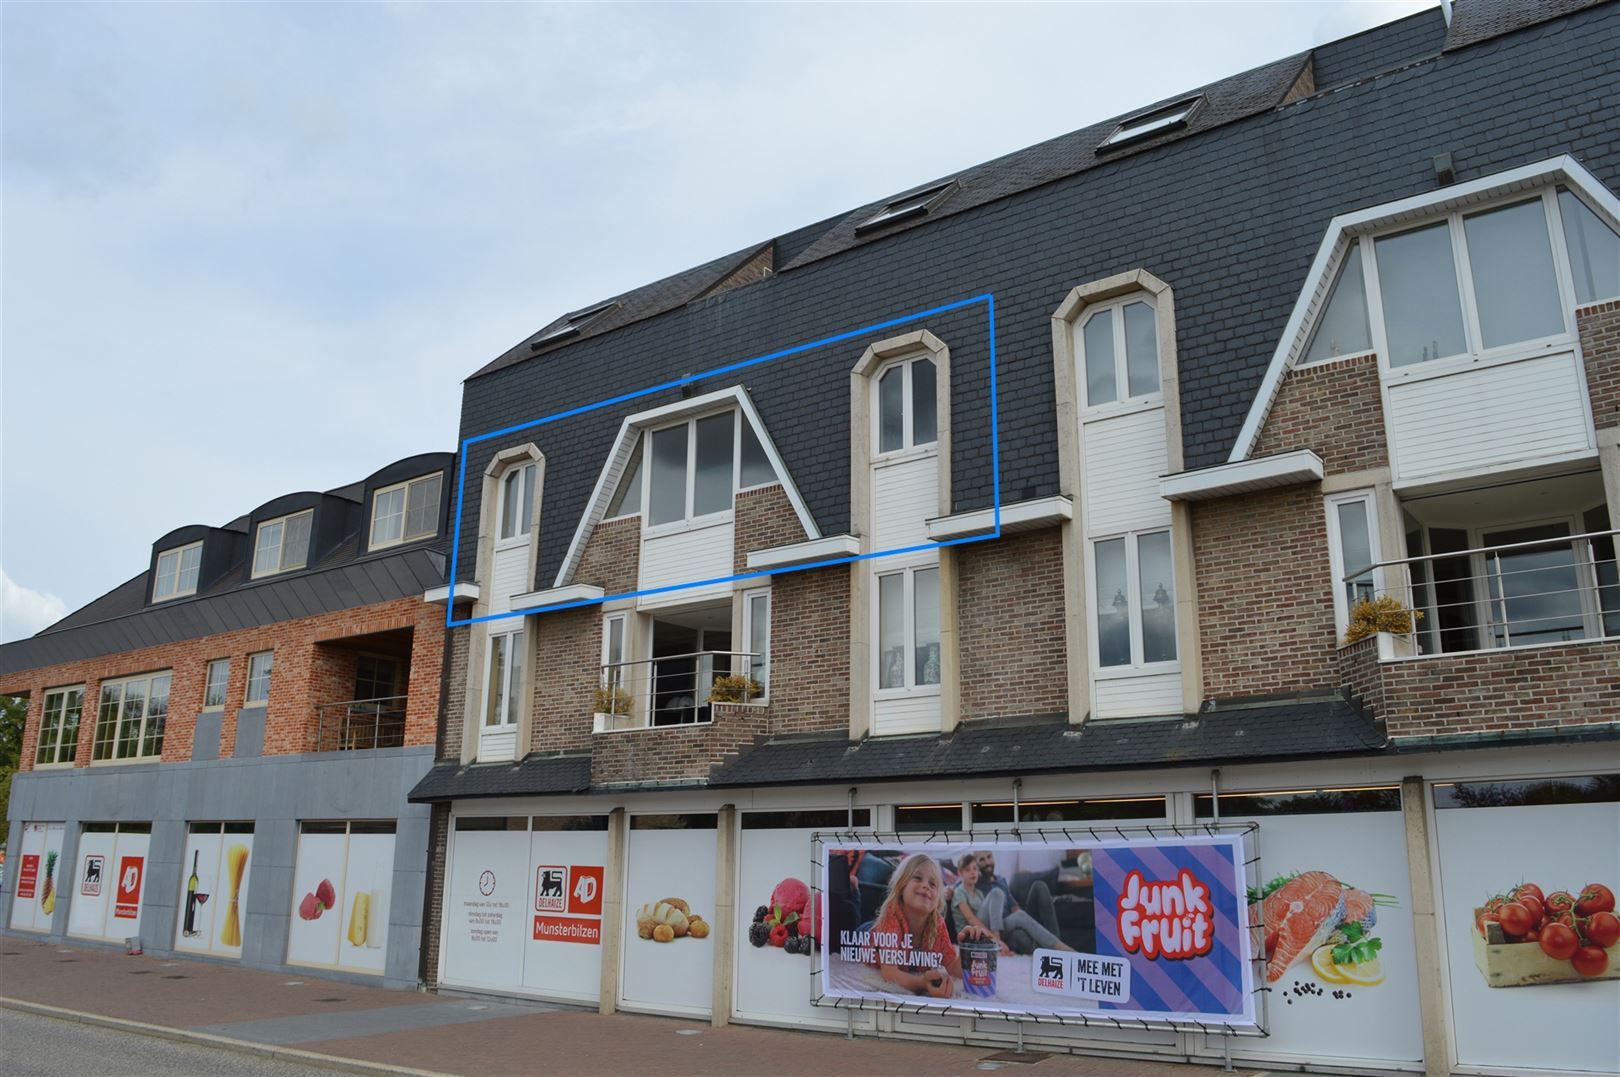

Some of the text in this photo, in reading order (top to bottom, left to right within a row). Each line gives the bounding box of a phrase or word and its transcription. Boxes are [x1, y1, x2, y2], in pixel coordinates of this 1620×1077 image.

[573, 875, 597, 904] AD
[1120, 873, 1207, 916] Junk
[538, 897, 563, 909] DELHAIZE
[535, 921, 599, 938] Munsterbilzen
[1120, 910, 1208, 953] Fruit
[840, 930, 913, 949] KLAAR VOOR JE
[840, 947, 943, 968] NIEUWE VERSLAVING?
[1077, 959, 1123, 978] MEE MET
[1038, 978, 1064, 990] DELHAIZE
[1089, 979, 1121, 996] LEVEN
